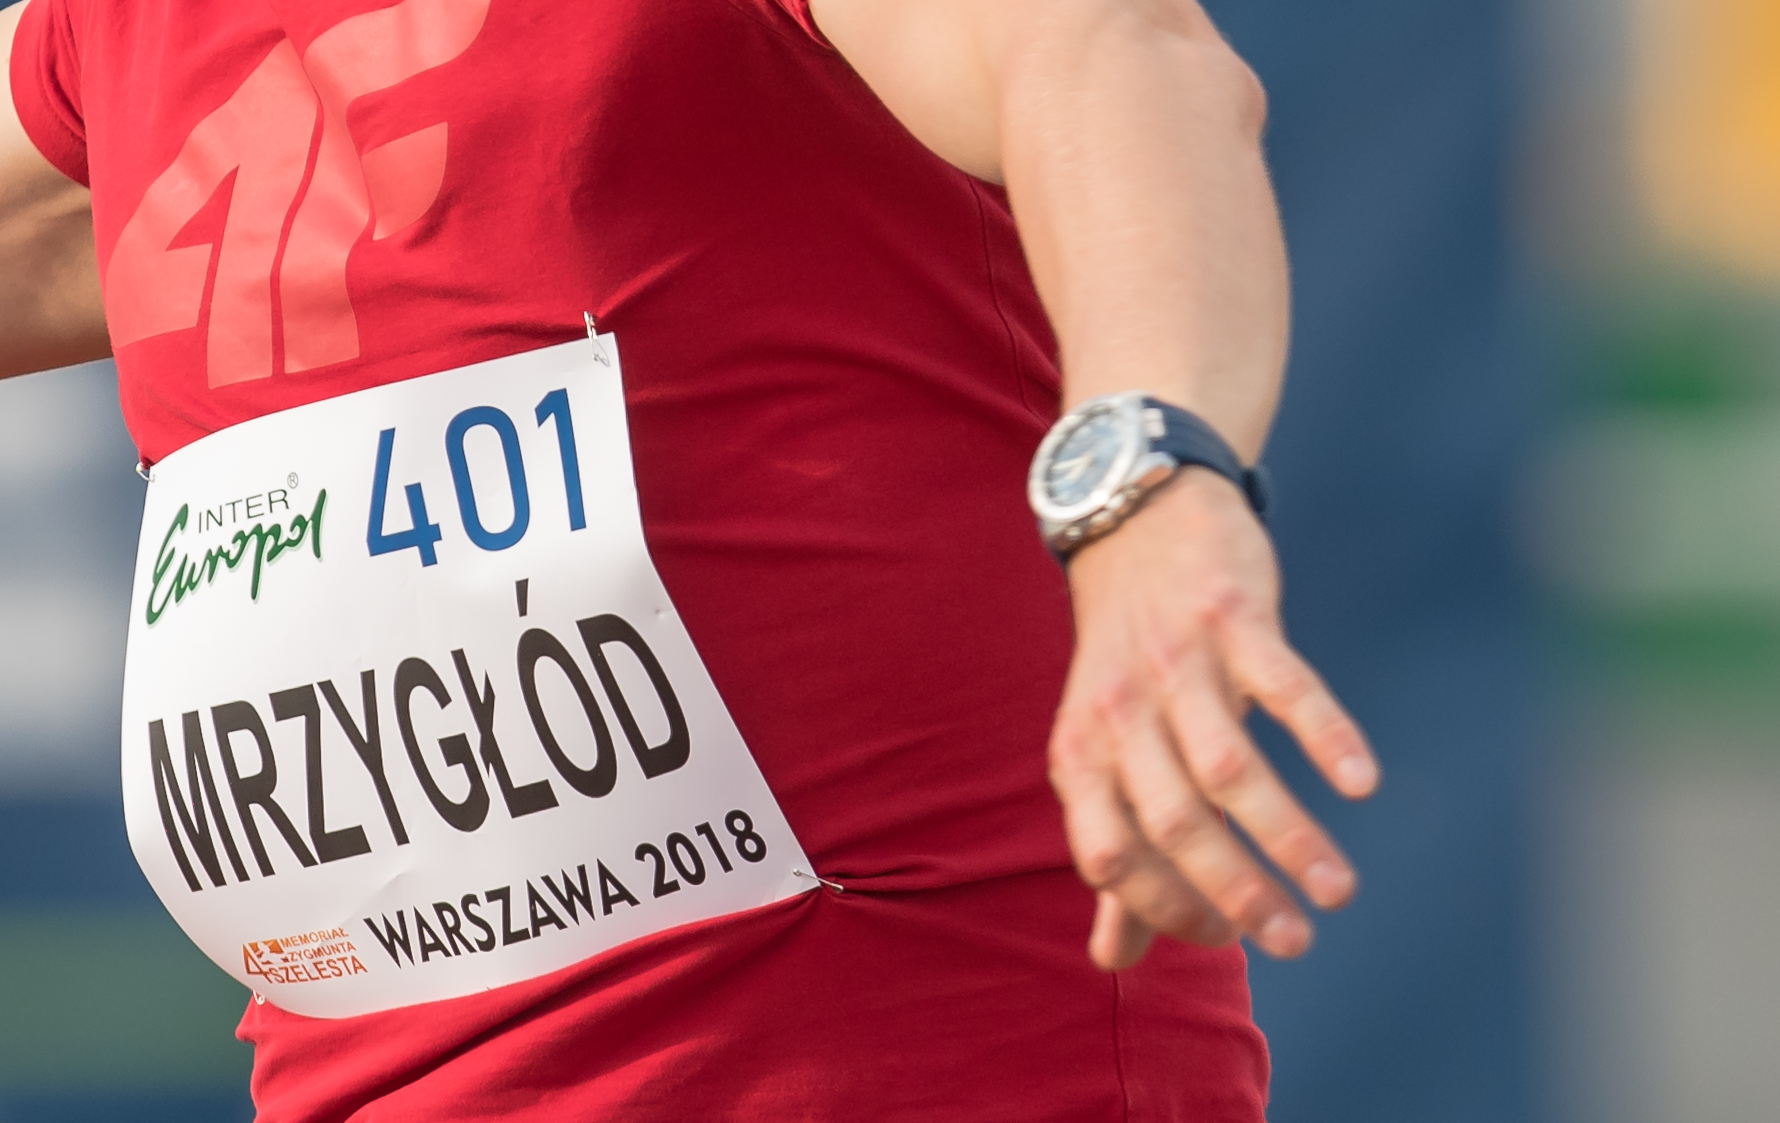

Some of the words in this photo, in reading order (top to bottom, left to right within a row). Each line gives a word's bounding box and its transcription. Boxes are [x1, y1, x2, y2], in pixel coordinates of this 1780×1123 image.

[366, 389, 587, 568] 401
[146, 488, 327, 626] Europol
[148, 578, 691, 893] MRZYGŁÓD
[279, 927, 350, 948] MEMORIAŁ
[288, 941, 358, 964] ZYGMUNTA
[363, 858, 641, 969] WARSZAWA
[634, 809, 768, 899] 2018
[267, 955, 369, 984] SZELESTA
